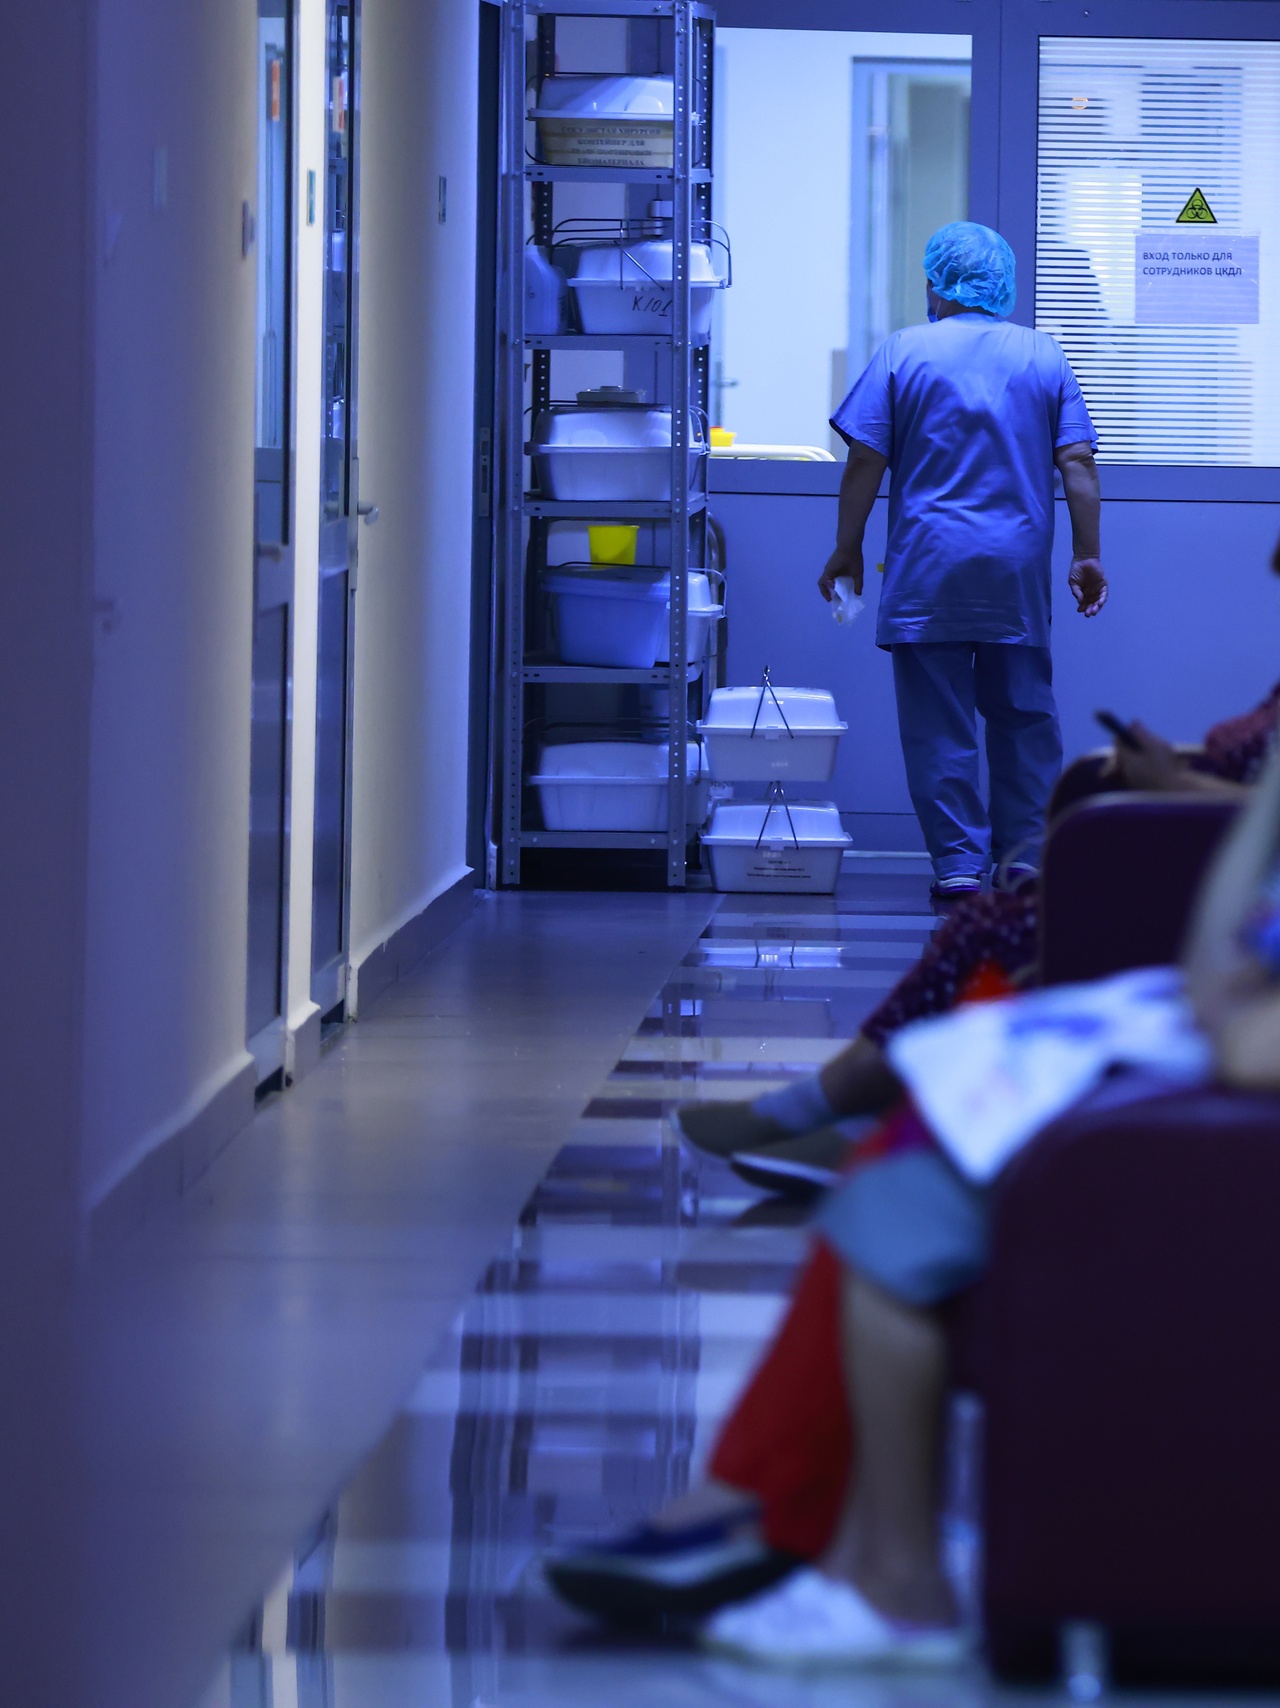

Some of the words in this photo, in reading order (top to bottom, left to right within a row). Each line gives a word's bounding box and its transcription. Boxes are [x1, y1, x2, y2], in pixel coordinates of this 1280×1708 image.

[1143, 252, 1169, 261] ВХОД
[1172, 252, 1210, 260] ТОЛЬКО
[1212, 252, 1233, 261] ДЛЯ
[1143, 267, 1213, 276] СОТРУДНИКОВ
[1215, 267, 1242, 276] ЦКДЛ
